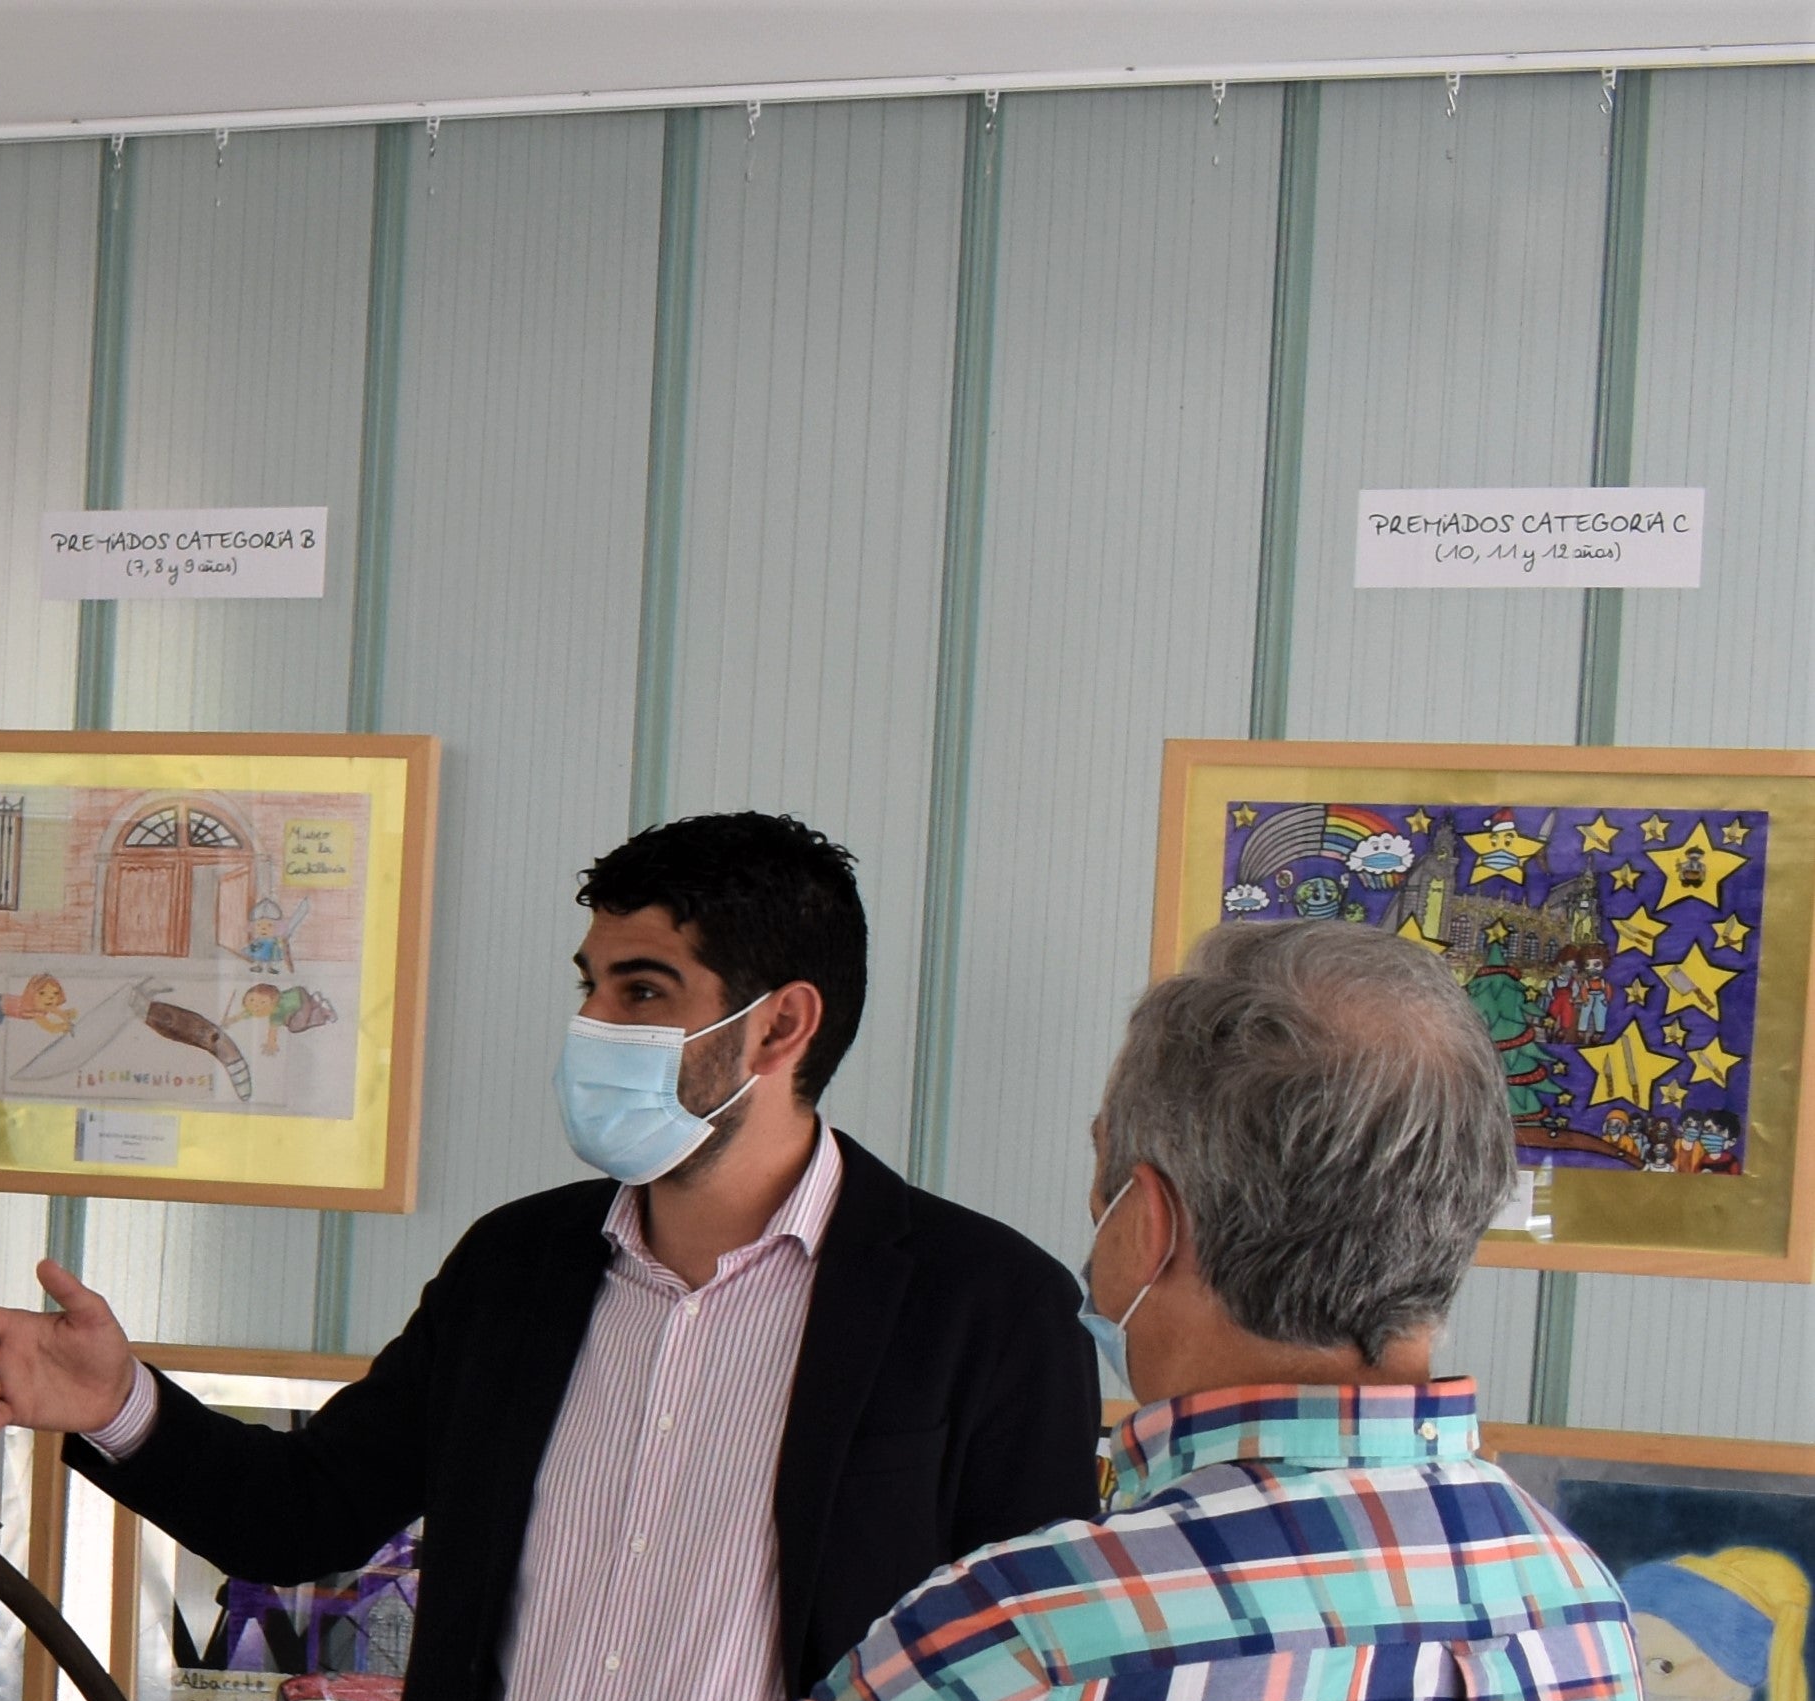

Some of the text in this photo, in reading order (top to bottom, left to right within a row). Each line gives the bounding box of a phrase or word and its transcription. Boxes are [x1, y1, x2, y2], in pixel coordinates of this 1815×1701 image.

[1369, 513, 1514, 536] PREMIADOS
[1672, 513, 1690, 533] C
[51, 533, 170, 552] PREMIADOS
[300, 529, 316, 550] B
[1434, 542, 1621, 572] (10, 11 y 12 años)
[126, 558, 149, 577] (7,
[154, 558, 164, 573] 8
[168, 565, 179, 585] y
[183, 557, 195, 573] 9
[177, 1672, 268, 1692] Albacete
